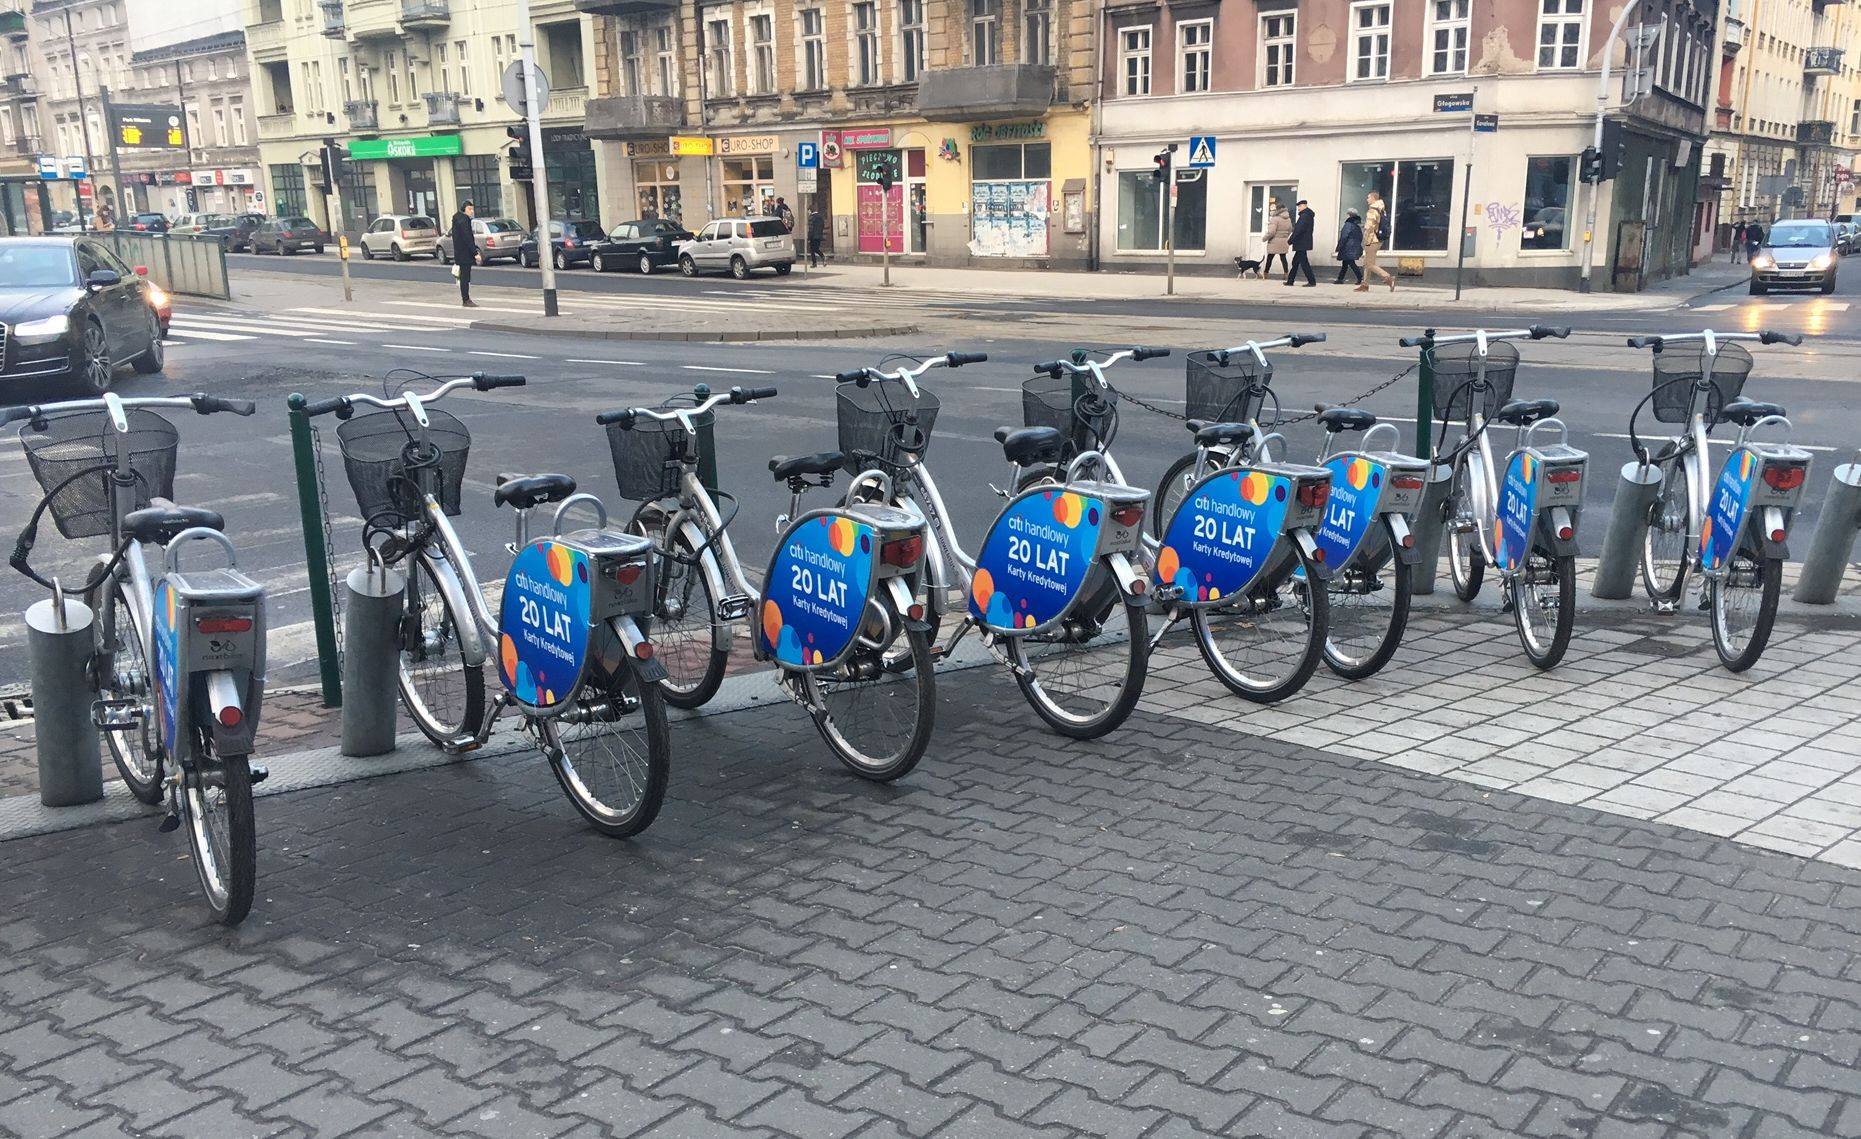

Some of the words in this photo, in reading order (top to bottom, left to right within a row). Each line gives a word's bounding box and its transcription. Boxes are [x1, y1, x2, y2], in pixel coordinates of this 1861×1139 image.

[801, 144, 813, 165] P
[1194, 496, 1210, 511] citi
[1211, 499, 1256, 525] handlowy
[1330, 503, 1356, 531] LAT
[1008, 517, 1023, 531] citi
[1024, 521, 1069, 549] handlowy
[1194, 515, 1217, 541] 20
[1221, 521, 1256, 550] LAT
[804, 546, 846, 578] handlowy
[1008, 536, 1031, 564] 20
[1036, 543, 1069, 576] LAT
[1192, 541, 1212, 556] Karty
[1213, 547, 1253, 568] Kredytowej
[791, 565, 813, 595] 20
[817, 573, 848, 608] LAT
[1007, 564, 1026, 581] Karty
[1027, 570, 1067, 596] Kredytowej
[519, 595, 540, 628] 20
[543, 605, 571, 643] LAT
[792, 595, 811, 613] Karty
[811, 602, 848, 629] Kredytowej
[523, 629, 541, 649] Karty
